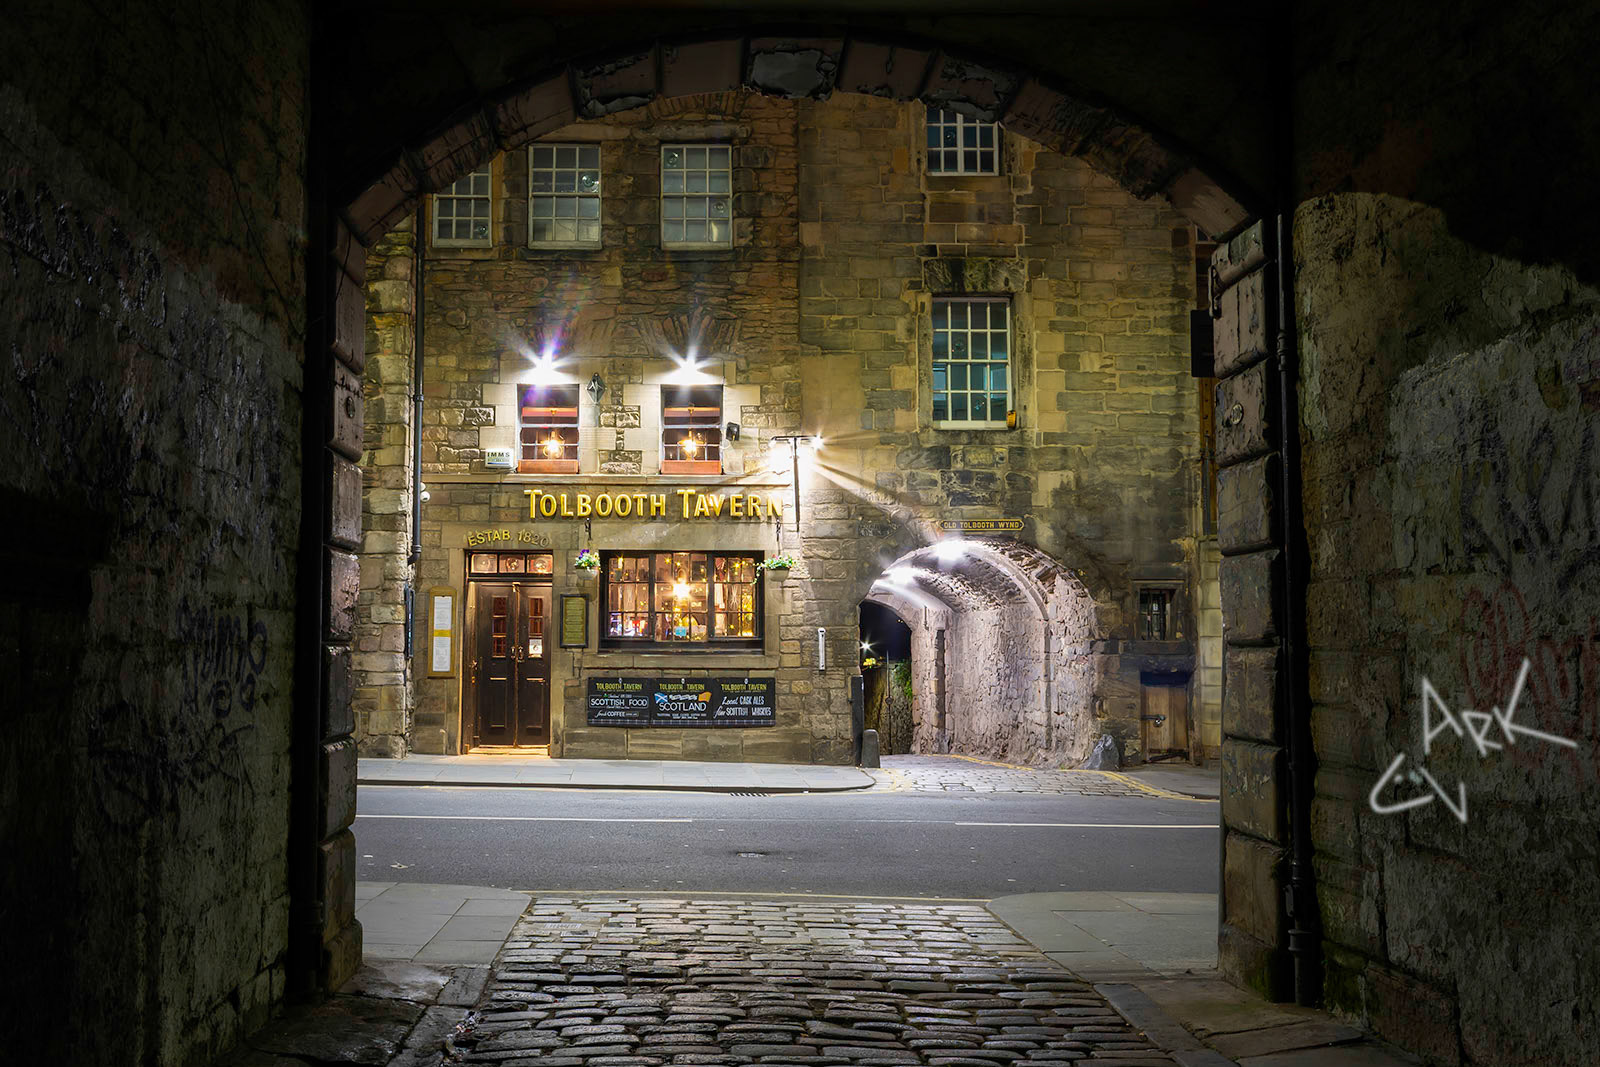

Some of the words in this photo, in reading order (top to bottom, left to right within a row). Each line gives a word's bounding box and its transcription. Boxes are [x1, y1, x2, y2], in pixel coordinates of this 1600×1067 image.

[524, 489, 666, 519] TOLBOOTH
[677, 489, 783, 519] TAVERN
[944, 521, 956, 529] OLD
[960, 521, 994, 529] TOLBOOTH
[998, 521, 1019, 529] WYND
[518, 530, 548, 547] 1820
[591, 698, 625, 706] SCOTTISH
[740, 696, 752, 705] CASK
[753, 696, 765, 705] ALES
[659, 702, 707, 711] SCOTLAND
[726, 707, 748, 716] SCOTTISH
